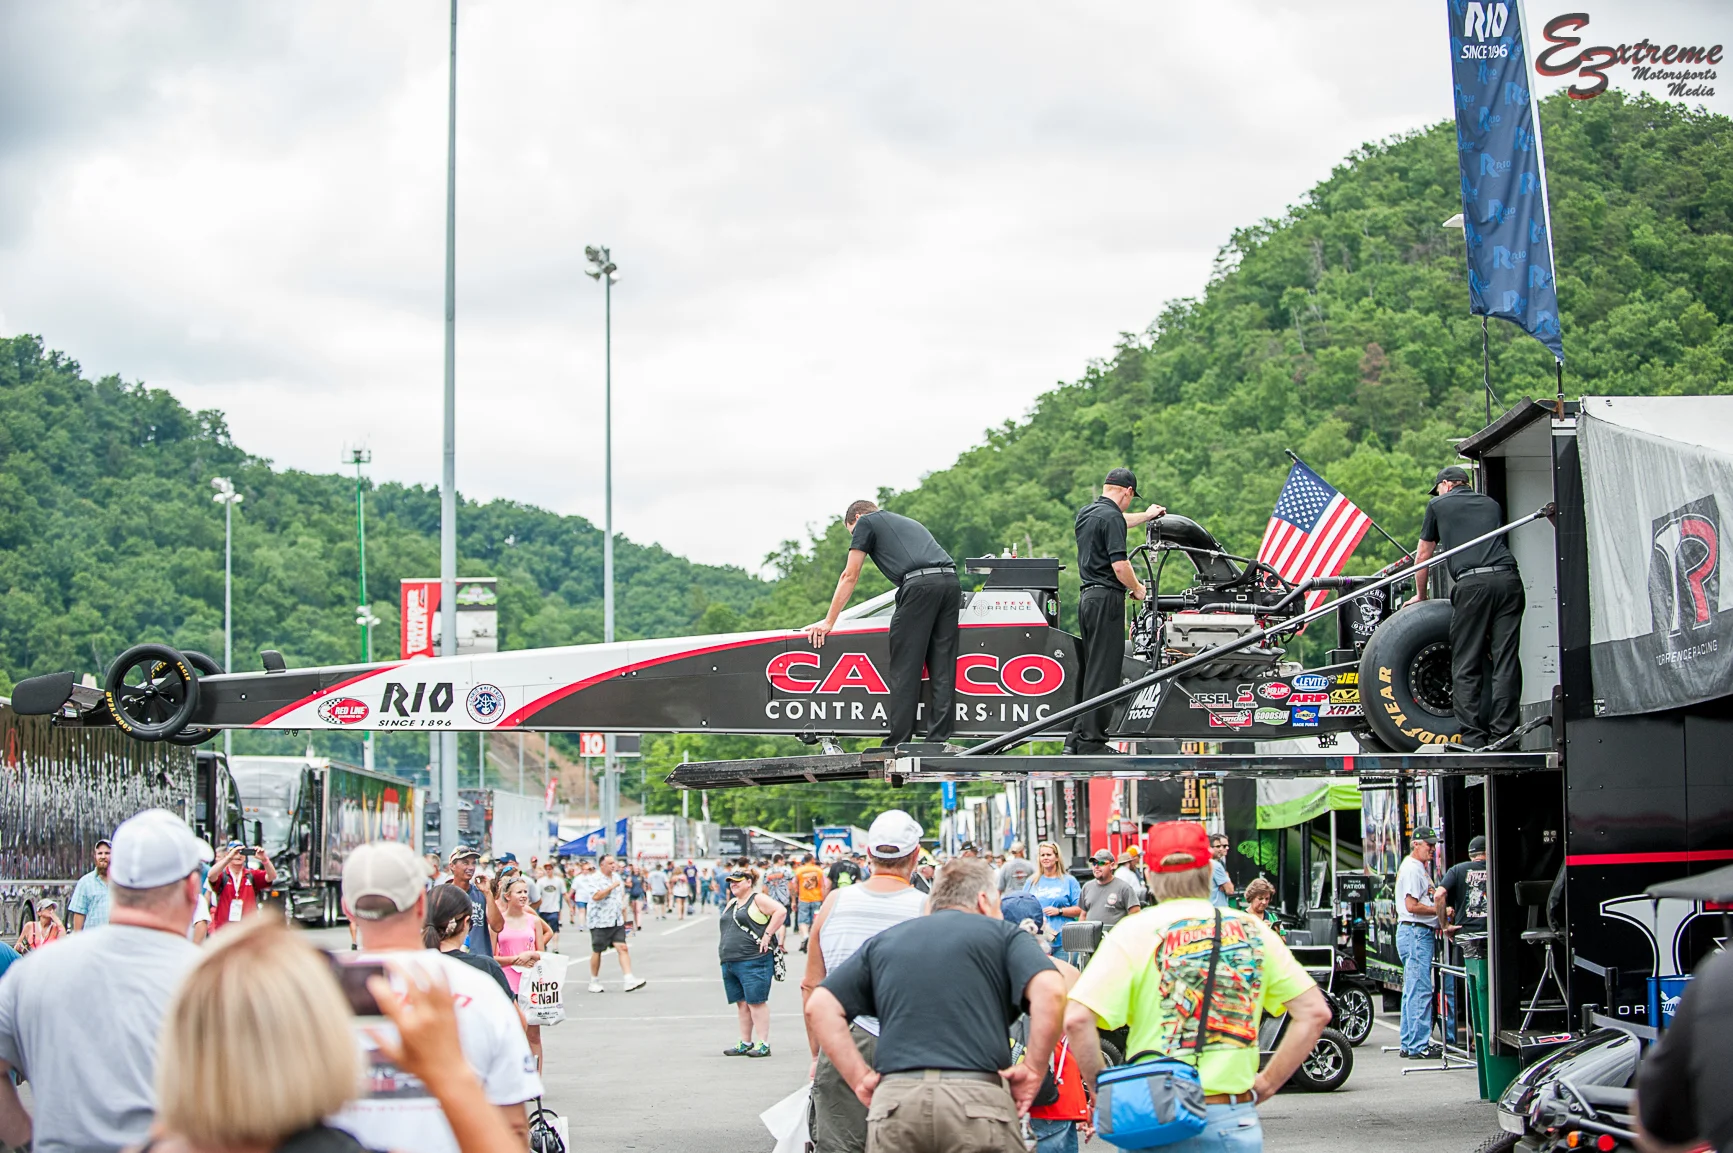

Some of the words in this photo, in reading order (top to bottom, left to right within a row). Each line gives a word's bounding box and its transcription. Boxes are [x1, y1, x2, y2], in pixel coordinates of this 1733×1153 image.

[1464, 2, 1508, 42] RIO
[1461, 45, 1487, 58] SINCE
[176, 661, 191, 681] EAGLE
[766, 651, 1065, 697] CACO
[1293, 675, 1328, 688] CLEVITE
[379, 683, 454, 717] RIO
[1190, 693, 1230, 704] JESEL
[1289, 694, 1328, 702] ARP
[1378, 666, 1463, 745] OODYEAR
[105, 691, 133, 732] GOODYEAR
[335, 707, 349, 715] RED
[350, 707, 365, 715] LINE
[765, 701, 991, 722] CONTRATRS
[1001, 703, 1051, 722] INC
[1128, 707, 1155, 720] TOOLS
[1255, 711, 1290, 721] GOODSON
[1326, 705, 1357, 716] XRP
[582, 735, 604, 755] 10
